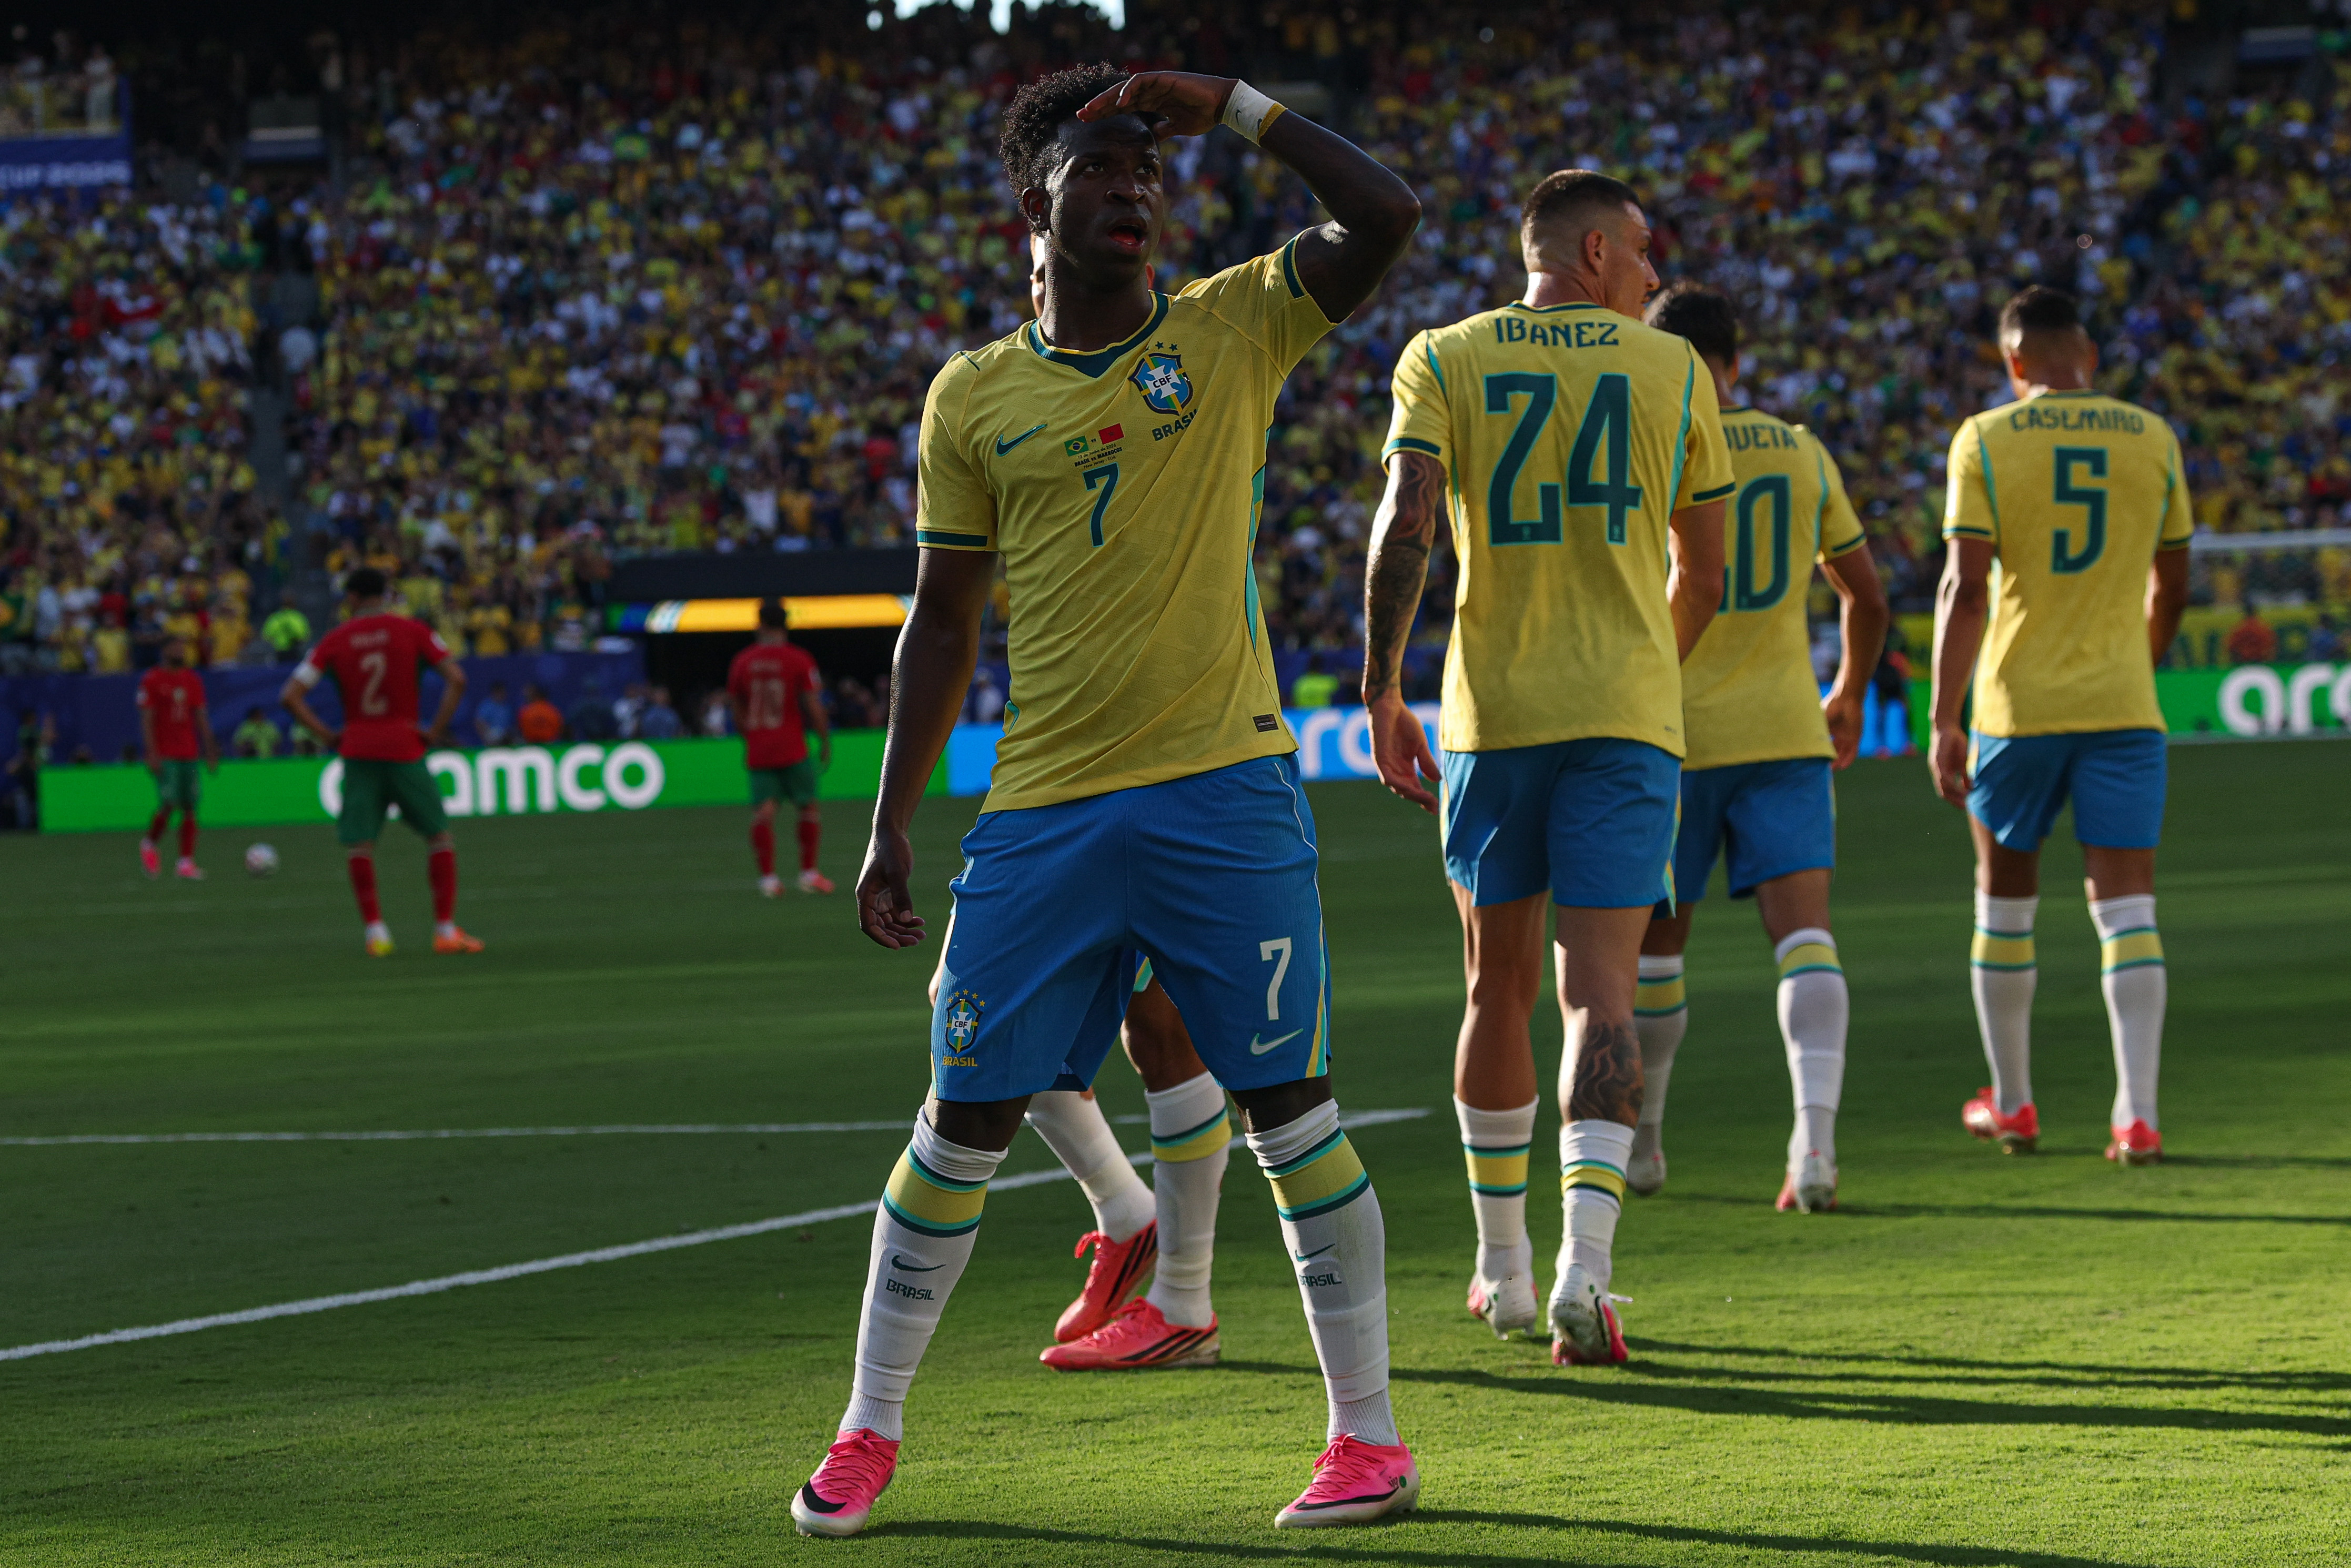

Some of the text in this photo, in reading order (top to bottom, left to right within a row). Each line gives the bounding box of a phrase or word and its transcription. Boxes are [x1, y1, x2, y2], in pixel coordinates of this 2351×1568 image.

[1153, 374, 1172, 389] CBF
[1074, 458, 1091, 467] BRASIL
[1097, 447, 1123, 459] MARROCOS
[1483, 370, 1643, 547] 24
[1082, 462, 1120, 548] 7
[1716, 473, 1791, 616] 0
[2051, 445, 2110, 575] 5
[359, 651, 388, 716] 2
[318, 741, 665, 822] amco
[1259, 936, 1293, 1021] 7
[942, 1056, 978, 1067] BRASIL
[885, 1278, 934, 1300] BRASIL
